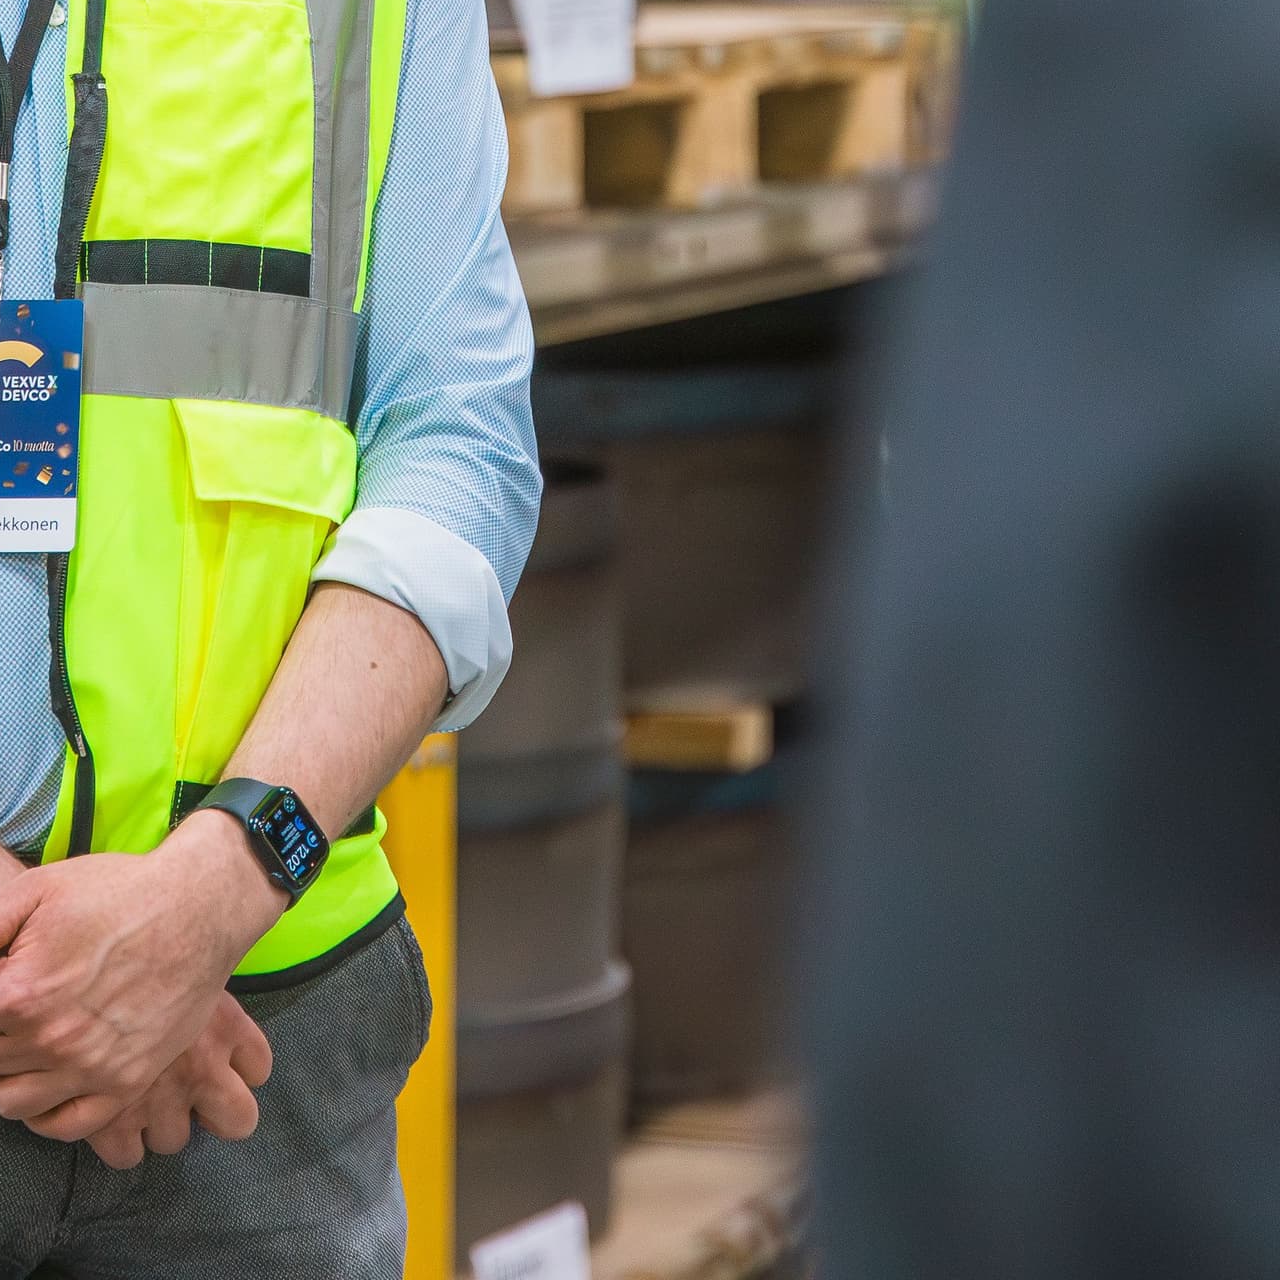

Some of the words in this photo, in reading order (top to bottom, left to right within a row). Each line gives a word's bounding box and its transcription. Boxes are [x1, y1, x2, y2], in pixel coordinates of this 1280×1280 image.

[2, 375, 46, 389] VEXVE
[1, 388, 51, 402] DEVCO
[12, 439, 23, 452] 10
[24, 440, 55, 452] vuotta
